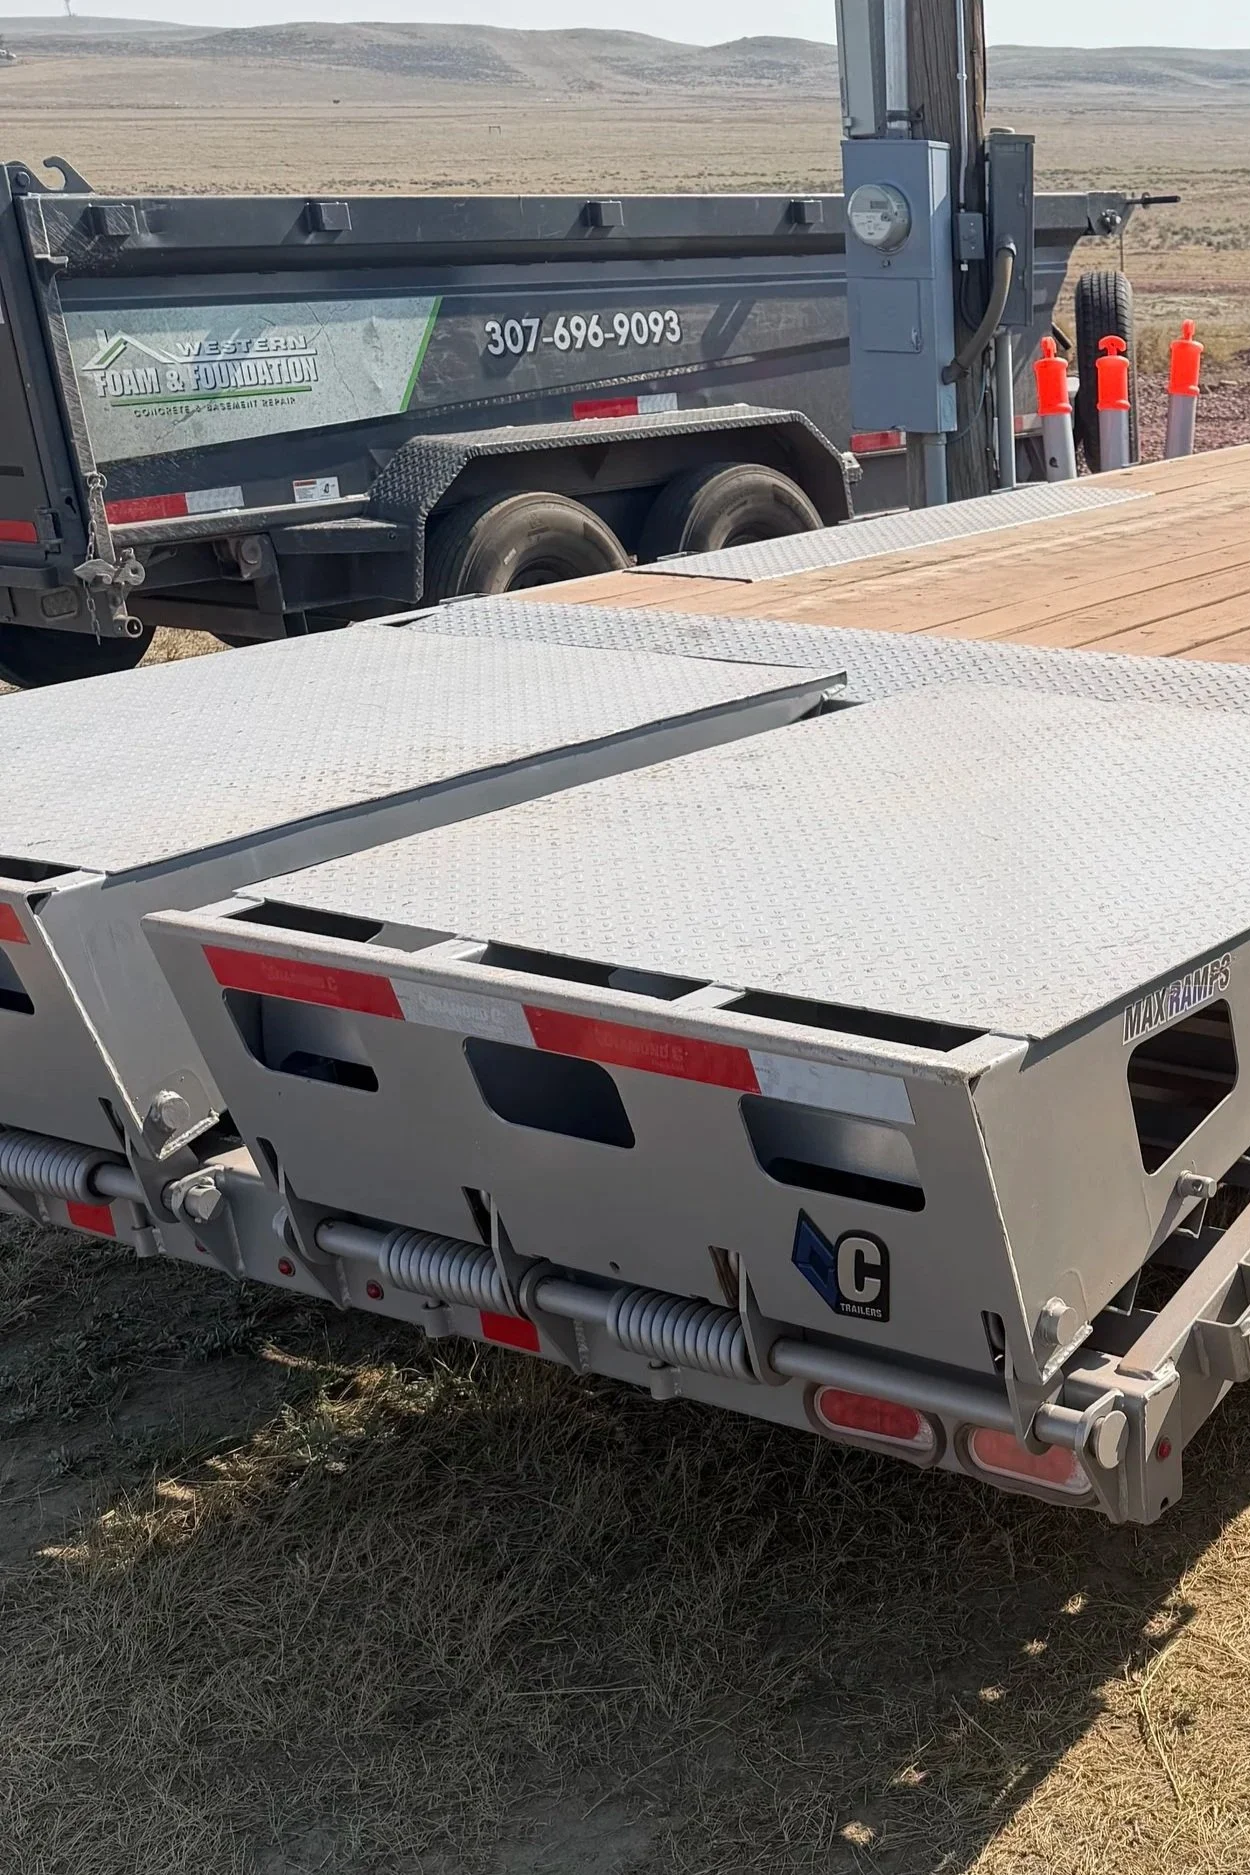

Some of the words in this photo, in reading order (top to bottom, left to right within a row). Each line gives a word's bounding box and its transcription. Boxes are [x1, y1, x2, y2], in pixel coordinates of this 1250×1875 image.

[176, 335, 307, 356] WESTERN
[484, 309, 682, 356] 307-696-9093
[94, 368, 160, 396] FOAM
[166, 370, 185, 392] &
[191, 357, 319, 391] FOUNDATION
[133, 405, 190, 418] CONCRETE
[206, 399, 258, 412] BASEMENT
[262, 396, 297, 407] REPAIR
[837, 1237, 881, 1303] C
[840, 1303, 882, 1318] TRAILERS
